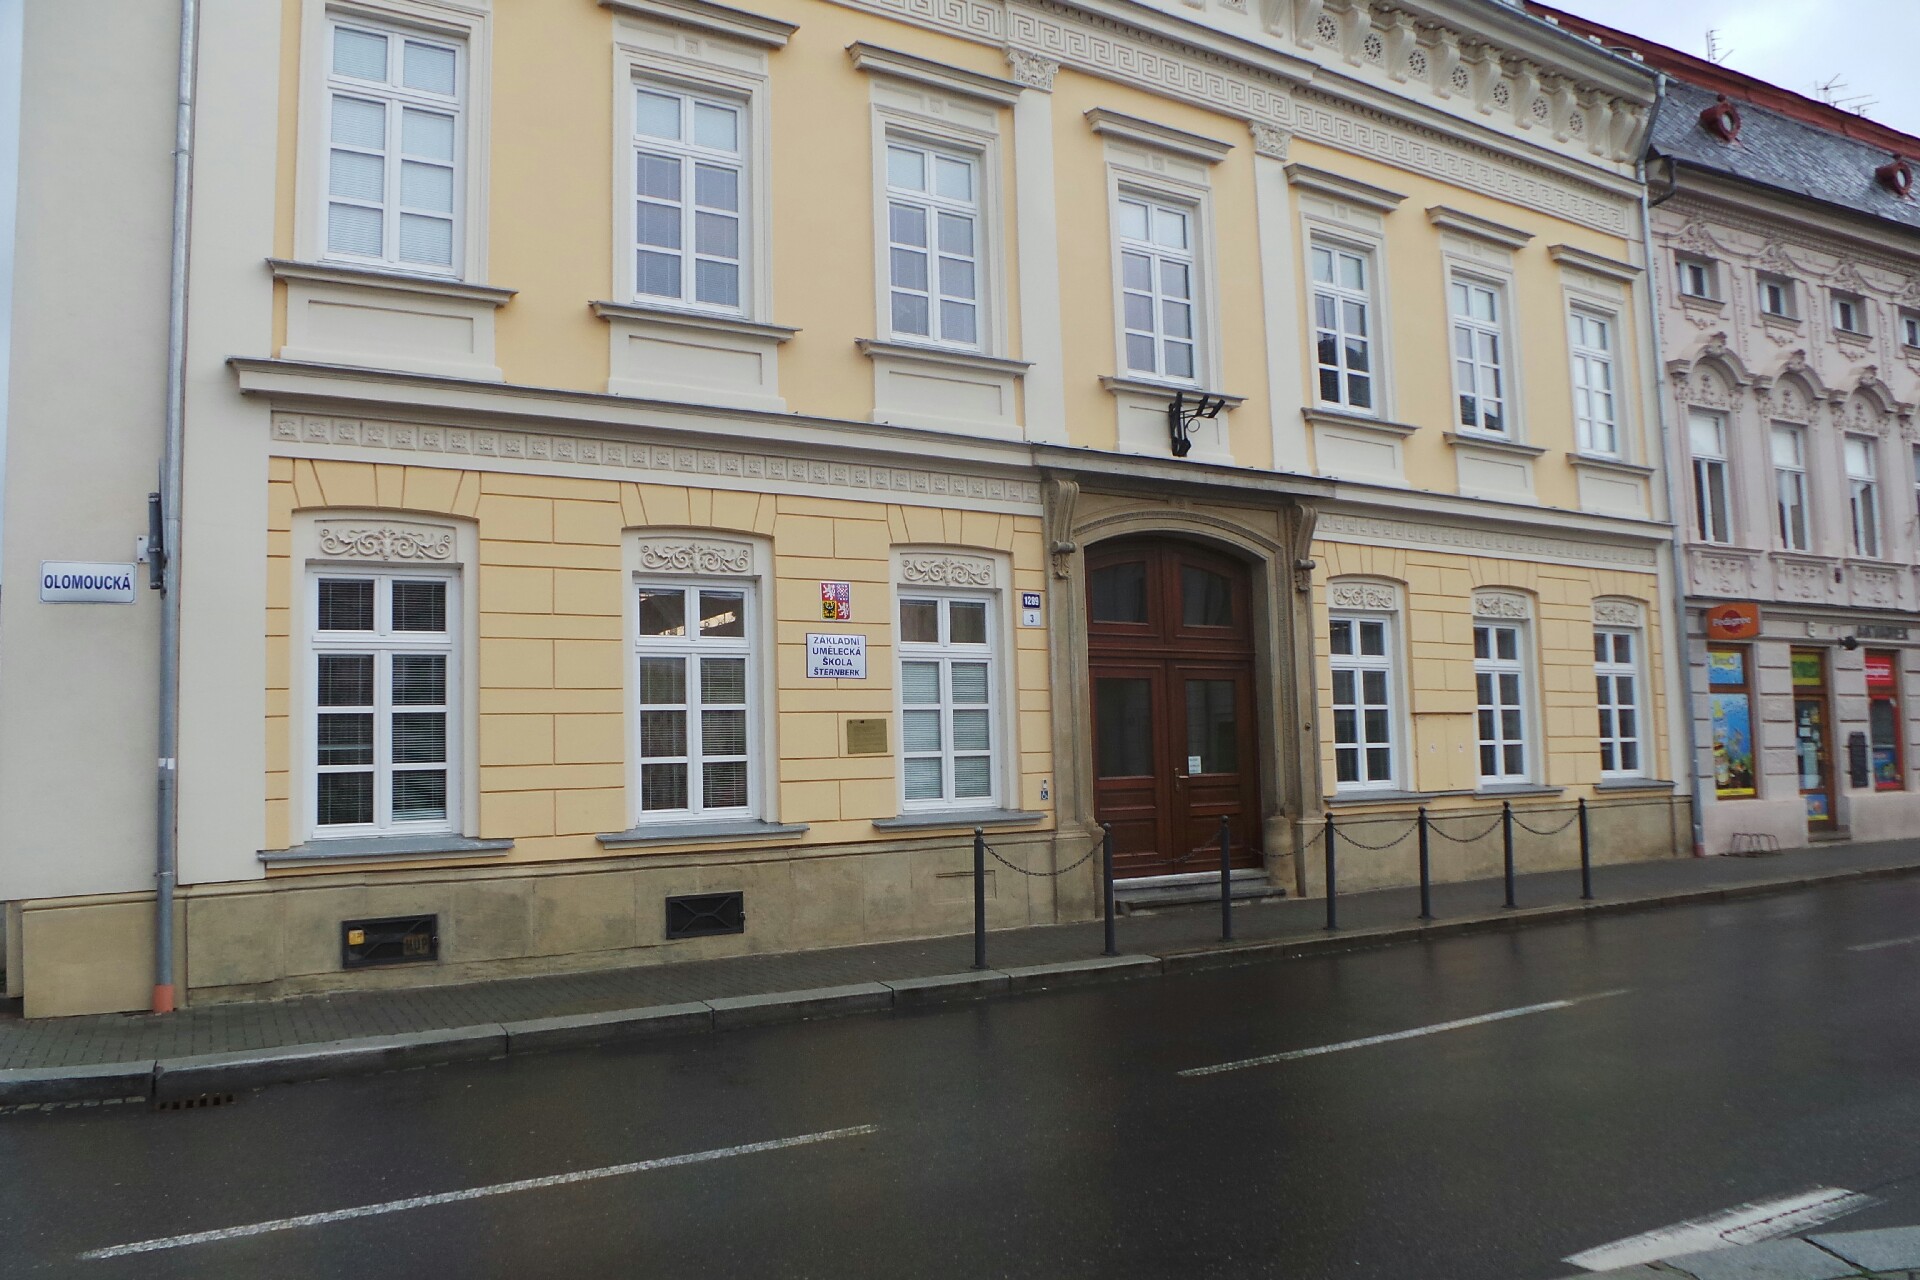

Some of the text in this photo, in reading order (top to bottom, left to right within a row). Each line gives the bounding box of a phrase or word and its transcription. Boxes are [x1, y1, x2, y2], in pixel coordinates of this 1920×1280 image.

[44, 573, 131, 590] OLOMOUCKÁ
[1024, 596, 1039, 606] 1289
[1029, 614, 1035, 623] 3
[813, 634, 860, 645] ZÁKLADNÍ
[812, 646, 861, 656] UMĚLECKÁ
[822, 656, 853, 666] ŠKOLA
[813, 667, 860, 676] ŠTERNBERK
